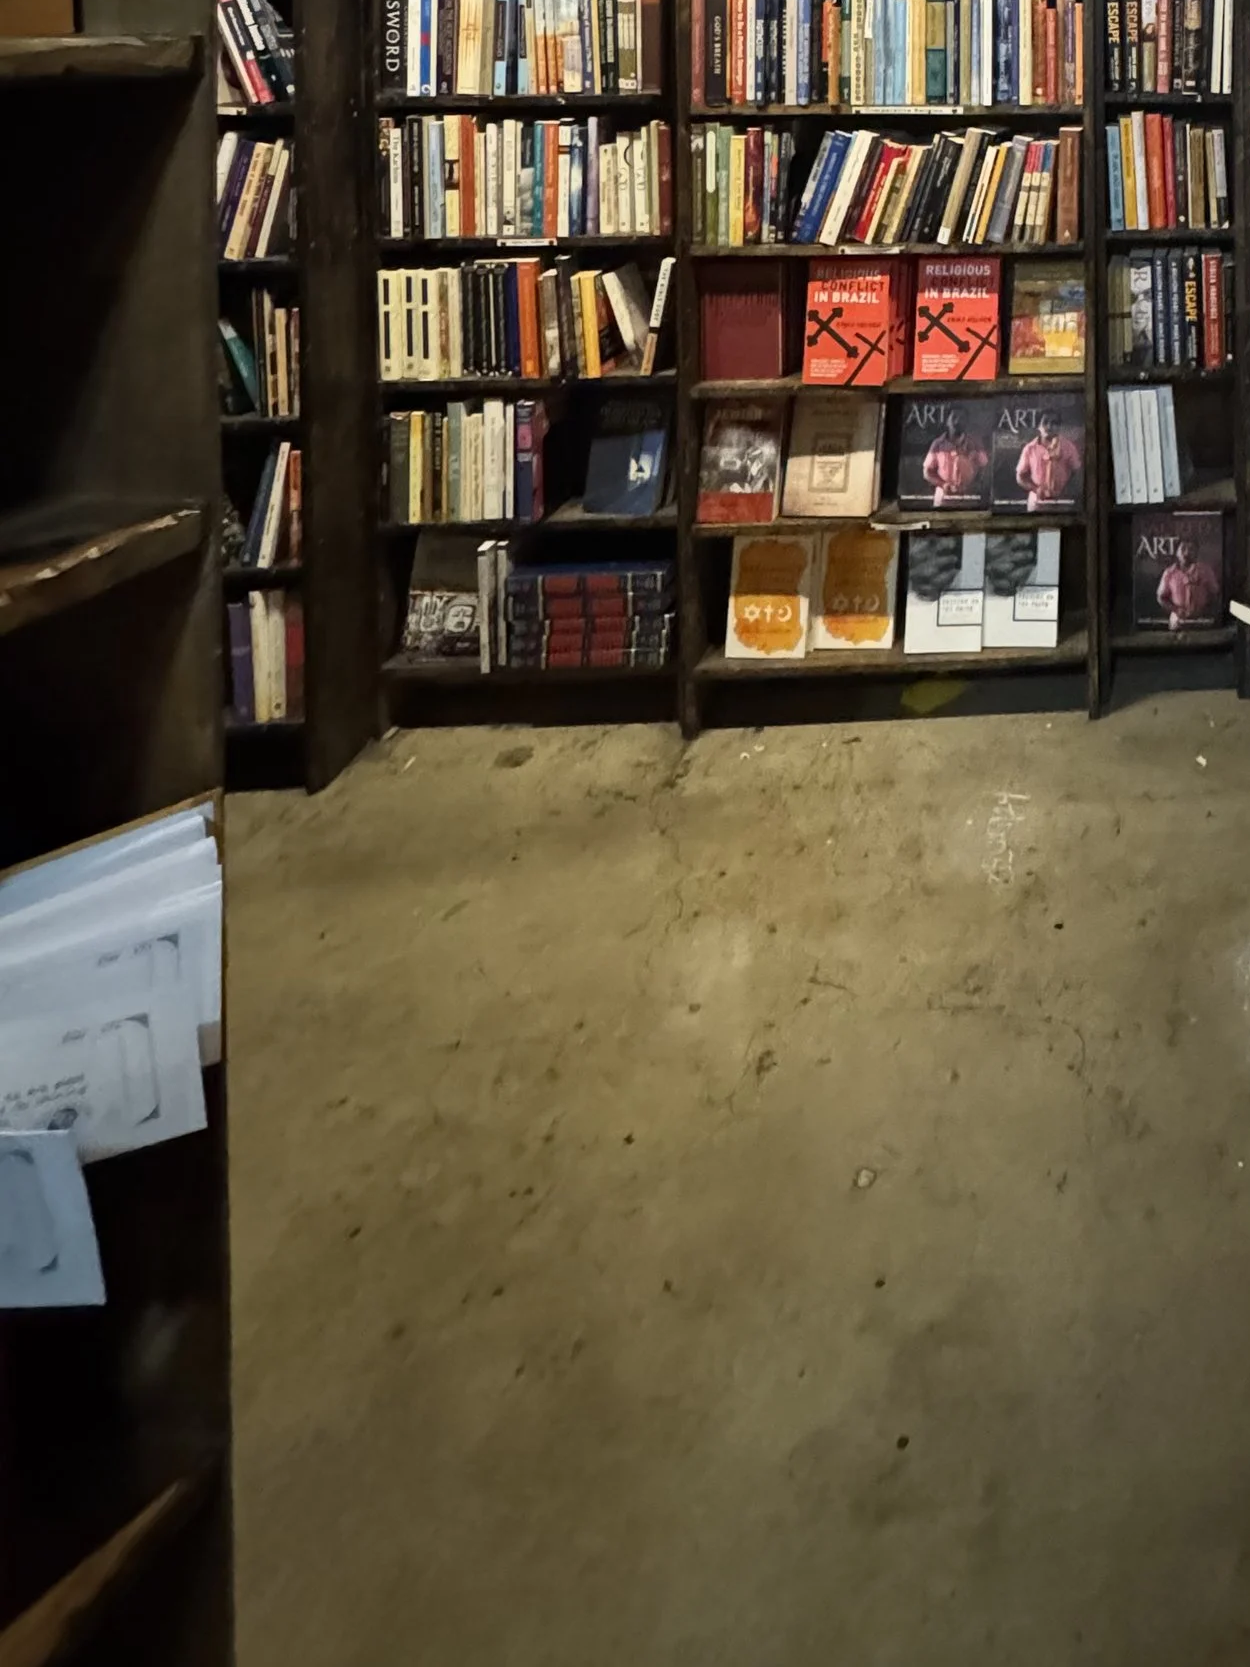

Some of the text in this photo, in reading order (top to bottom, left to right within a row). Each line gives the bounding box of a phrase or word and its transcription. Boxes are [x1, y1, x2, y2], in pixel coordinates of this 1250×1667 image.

[1107, 2, 1120, 44] ESCAPE
[1126, 1, 1138, 43] ESCAPE
[386, 0, 400, 72] SWORD
[926, 265, 991, 276] RELIGIOUS
[814, 291, 880, 304] IN BRAZIL
[821, 281, 885, 292] CONFLICT
[924, 288, 990, 299] IN BRAZIL
[1185, 281, 1197, 322] ESCAPE
[906, 403, 950, 429] ART
[998, 408, 1040, 433] ART
[1136, 535, 1180, 559] ART
